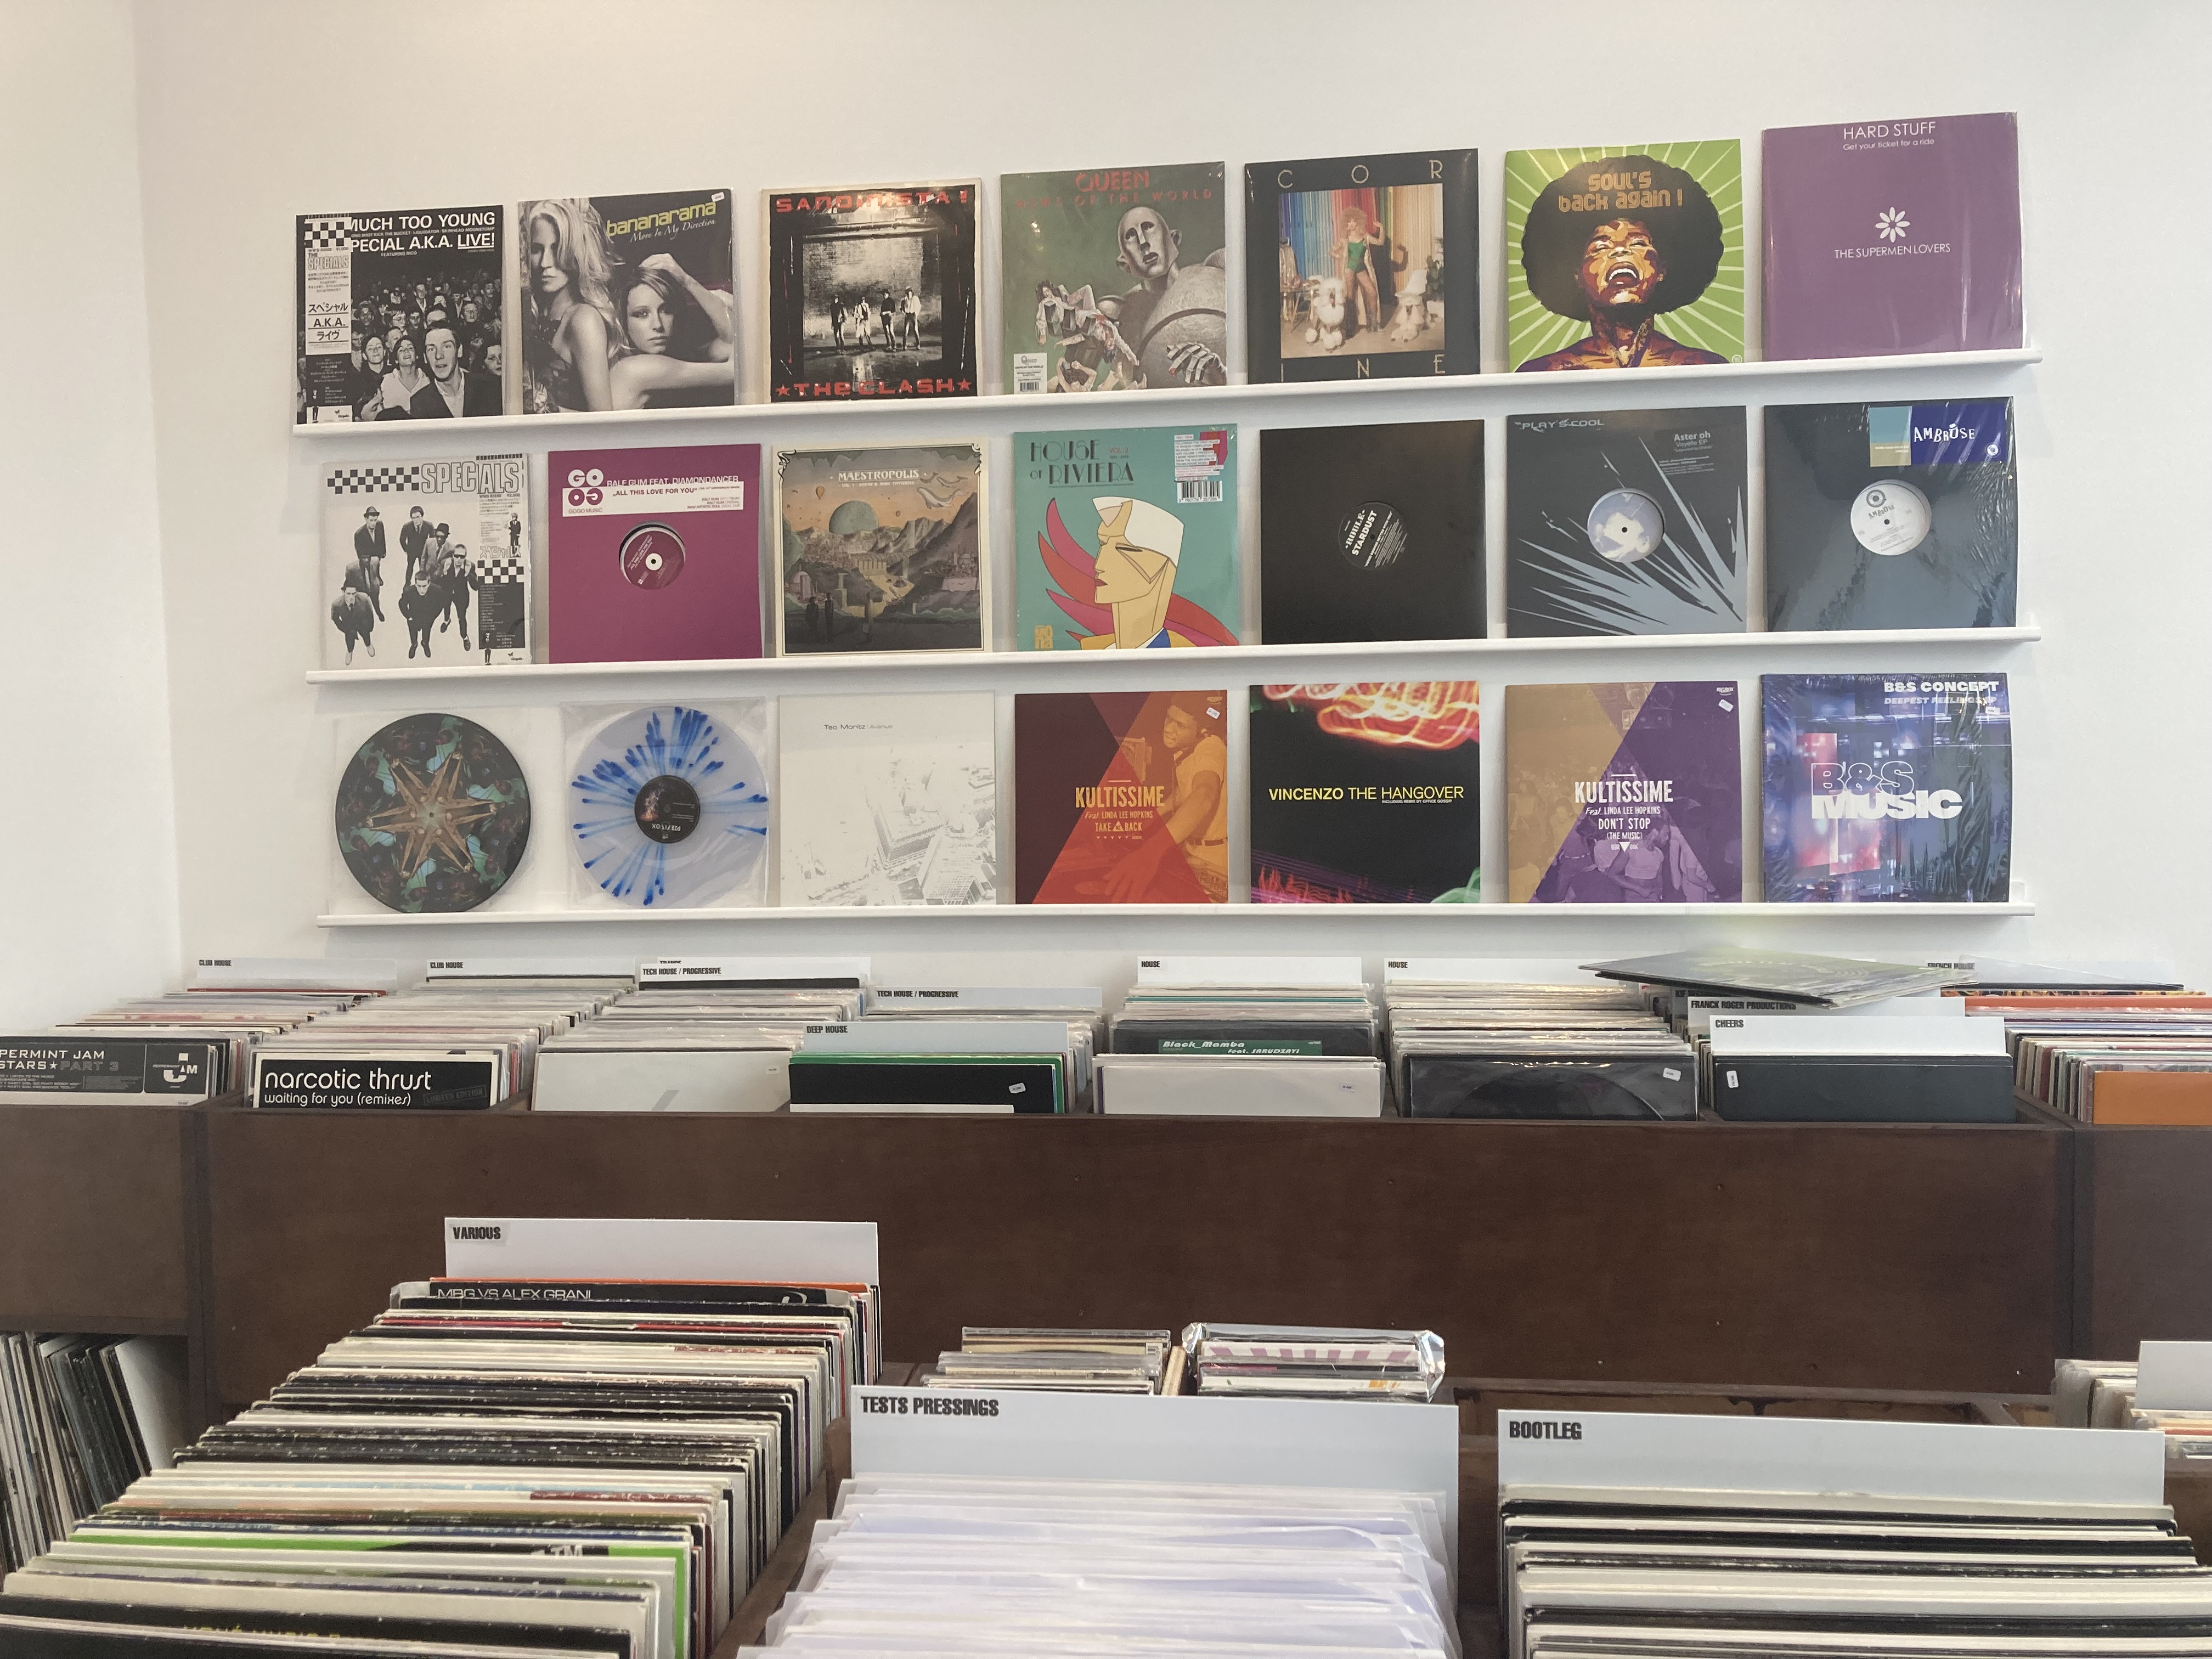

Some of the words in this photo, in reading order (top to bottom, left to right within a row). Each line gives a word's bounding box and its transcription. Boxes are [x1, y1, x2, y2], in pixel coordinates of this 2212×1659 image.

[1843, 124, 1889, 139] HARD
[1893, 121, 1936, 136] STUFF
[1859, 142, 1876, 150] your
[1877, 139, 1899, 148] ticket
[1901, 139, 1911, 147] for
[1920, 137, 1935, 146] ride
[1075, 170, 1149, 192] QUEEN
[1075, 194, 1096, 206] OF
[1109, 193, 1139, 205] THE
[1152, 188, 1212, 201] WORLD
[399, 215, 432, 229] TOO
[438, 212, 495, 227] YOUNG
[607, 202, 716, 237] bananarama
[630, 229, 652, 243] Move
[664, 225, 680, 240] My
[682, 219, 716, 231] Direction
[351, 236, 404, 252] PECIAL
[409, 235, 453, 249] A.K.A.
[458, 233, 495, 247] LIVE!
[1835, 249, 1854, 258] THE
[1856, 245, 1911, 258] SUPERMEN
[1914, 243, 1951, 254] LOVERS
[308, 256, 349, 270] SPECIALS
[308, 302, 348, 313] スペシャル
[313, 317, 346, 328] A.K.A.
[859, 379, 955, 395] CLASH
[1674, 433, 1697, 442] Aster
[1699, 431, 1711, 439] oh
[1914, 423, 1975, 443] AMBROSE
[1031, 439, 1101, 462] HOUSE
[568, 468, 603, 487] GO
[673, 476, 739, 484] DIAMONDANCER
[838, 470, 919, 482] MAESTROPOLIS
[1049, 462, 1134, 484] RIVIERA
[1868, 505, 1895, 520] AMBROSE
[1351, 510, 1378, 556] STARDUST
[1884, 681, 1917, 692] B&S
[1920, 681, 1999, 692] CONCEPT
[1811, 761, 1915, 797] B&S
[1075, 786, 1165, 808] KULTISSIME
[1268, 787, 1344, 800] VINCENZO
[1347, 787, 1377, 800] THE
[1381, 786, 1464, 800] HANGOVER
[1575, 780, 1674, 803] KULTISSIME
[1604, 806, 1621, 815] LINDA
[1623, 806, 1633, 815] LEE
[1635, 806, 1661, 815] HOPKINS
[1812, 789, 1963, 820] MUSIC
[1130, 810, 1153, 819] HOPKINS
[1094, 822, 1111, 832] TAKE
[1125, 822, 1142, 831] BACK
[1598, 817, 1624, 830] DON'T
[1628, 817, 1651, 830] STOP
[1606, 832, 1621, 840] (THE
[1622, 832, 1643, 840] MUSIC)
[1691, 1000, 1719, 1008] FRANCK
[1721, 1001, 1745, 1009] ROGER
[1747, 1001, 1796, 1010] PRODUCTIONS
[825, 1025, 848, 1034] HOUSE
[1715, 1019, 1744, 1028] CHEERS
[1163, 1041, 1245, 1049] Black_Mamba
[0, 1049, 68, 1059] PERMINT
[73, 1050, 105, 1059] JAM
[0, 1060, 47, 1070] STARS
[60, 1061, 103, 1071] PART
[109, 1061, 119, 1071] 3
[264, 1068, 361, 1090] narcotic
[369, 1068, 432, 1090] thrust
[264, 1091, 309, 1106] waiting
[311, 1092, 328, 1104] for
[331, 1095, 354, 1106] you
[357, 1092, 411, 1107] (remixes)
[453, 1226, 501, 1240] VARIOUS
[438, 1289, 475, 1299] MBG
[477, 1289, 498, 1299] VS
[861, 1396, 908, 1414] TESTS
[913, 1397, 999, 1417] PRESSINGS
[1509, 1420, 1582, 1440] BOOTLEG
